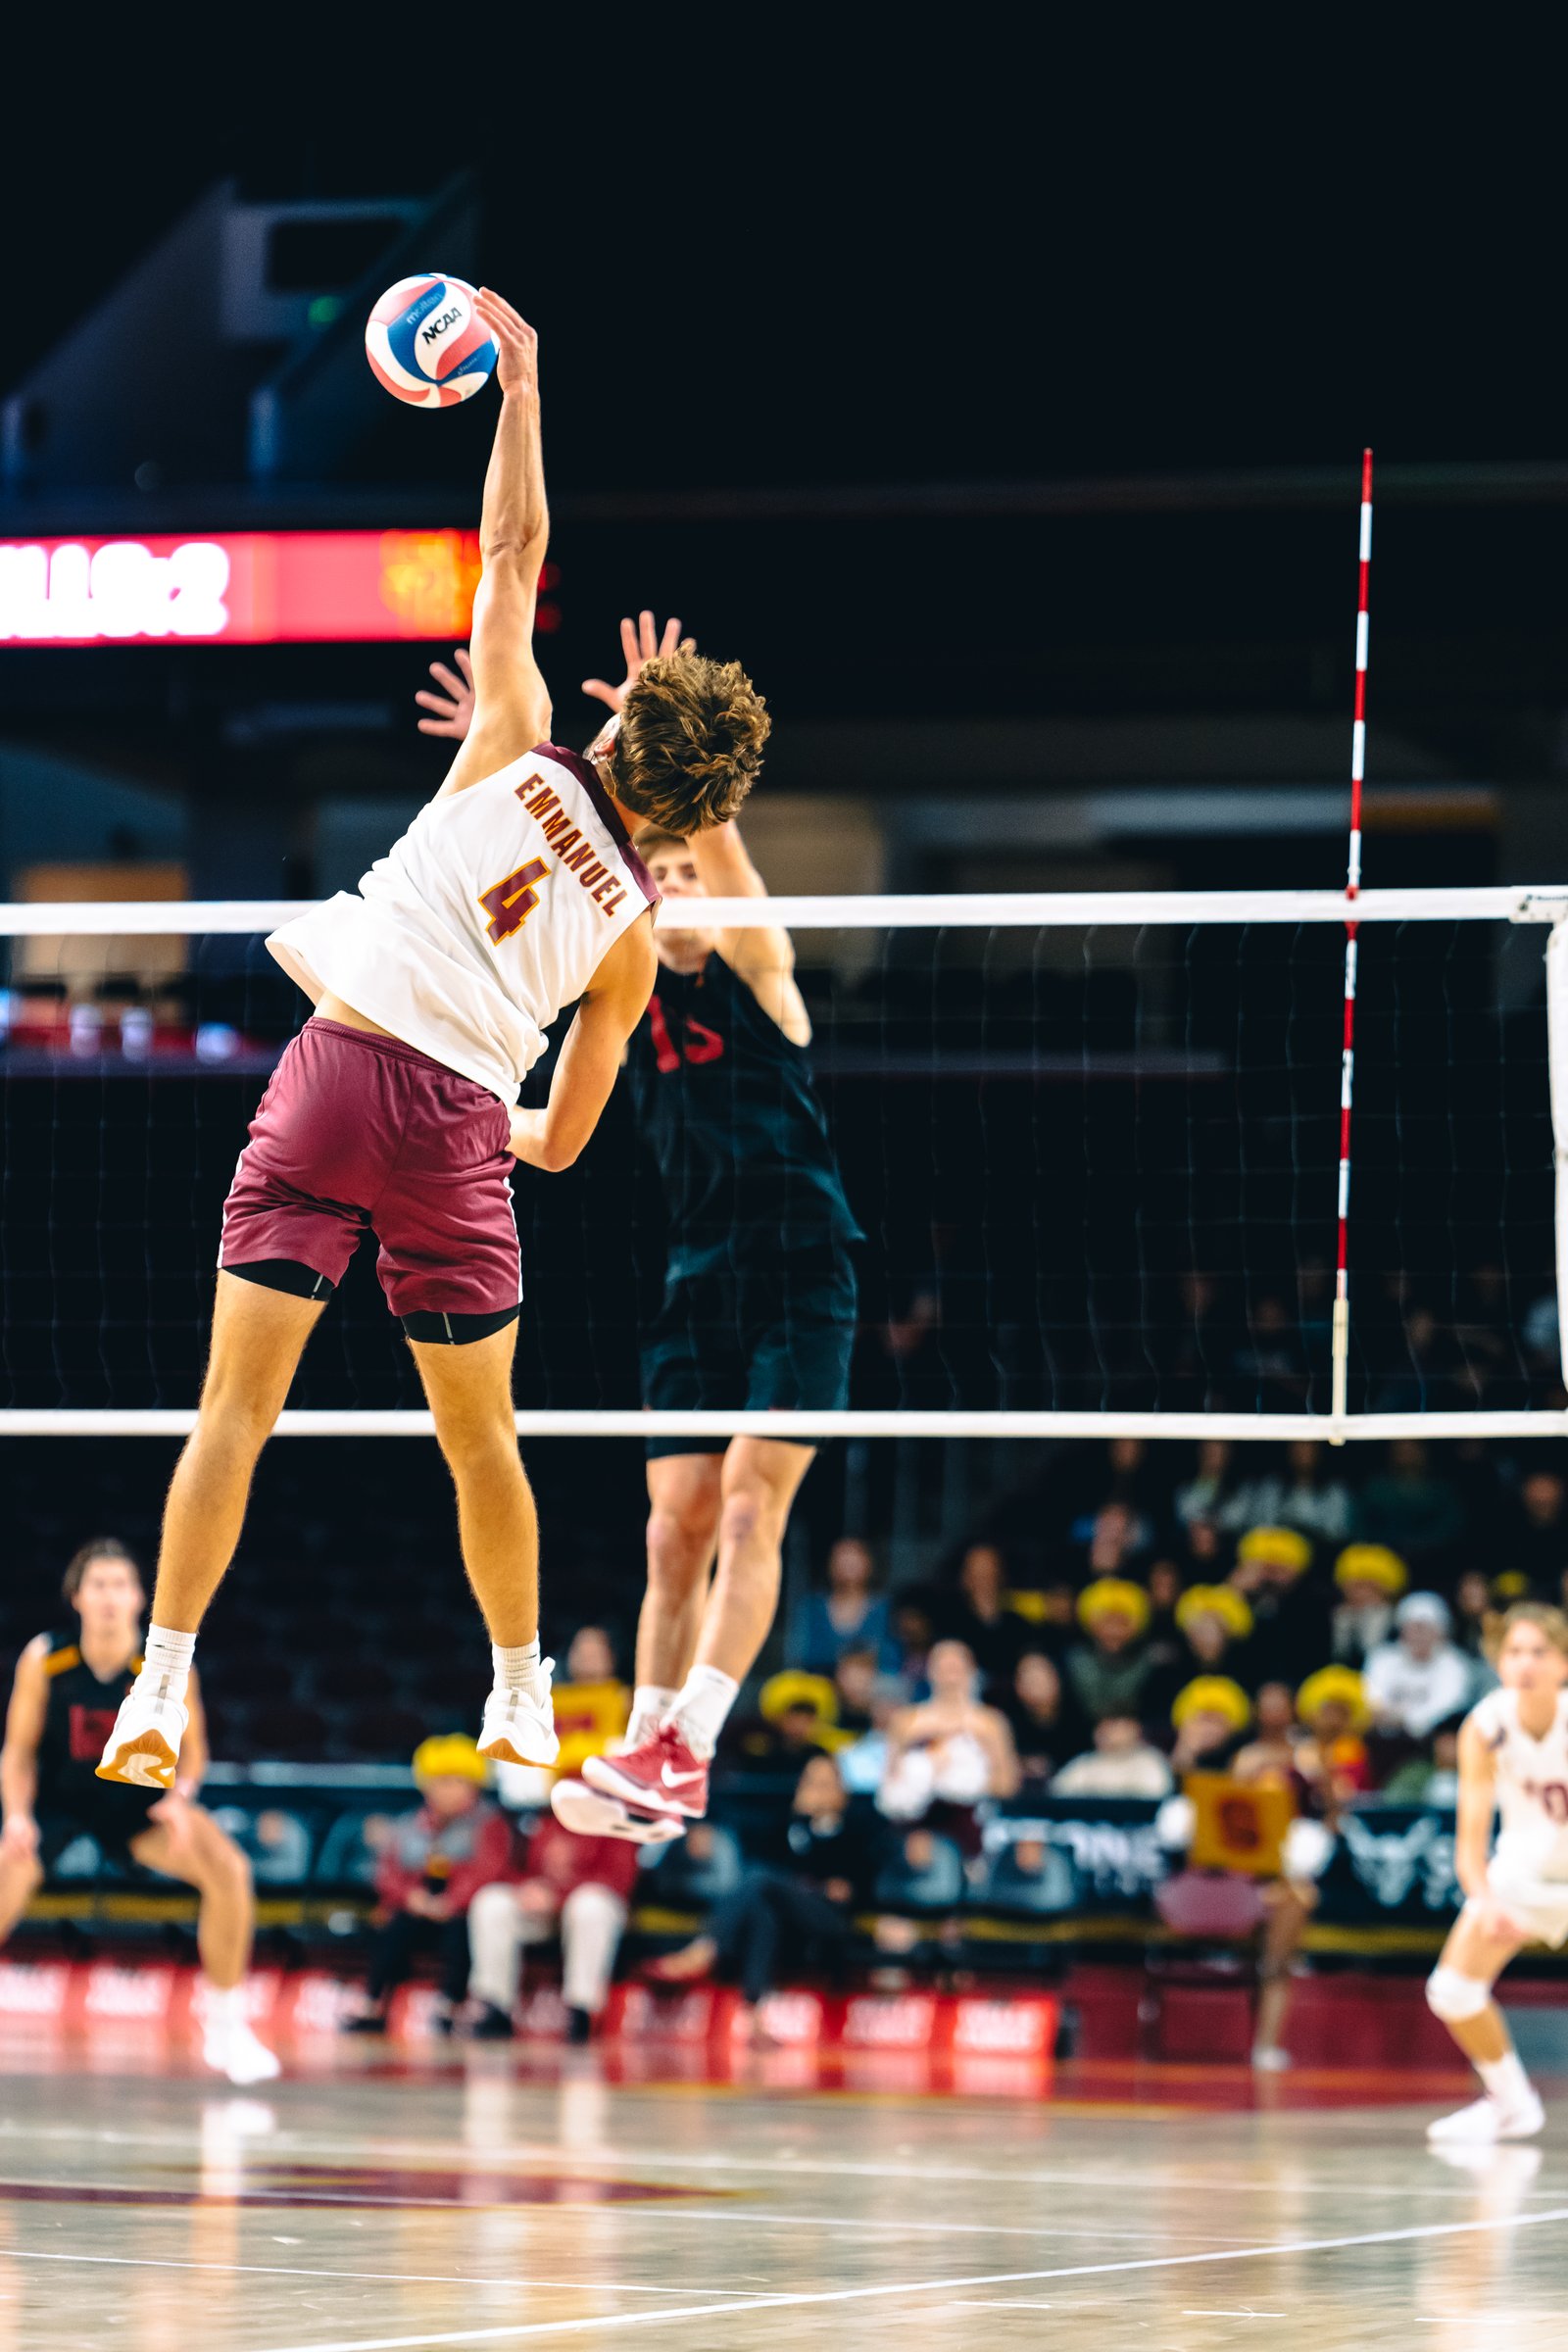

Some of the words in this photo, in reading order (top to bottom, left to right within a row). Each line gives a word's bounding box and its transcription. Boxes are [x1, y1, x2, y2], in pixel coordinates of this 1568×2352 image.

[421, 307, 463, 345] NCAA
[514, 772, 628, 917] EMMANUEL
[477, 856, 552, 947] 4
